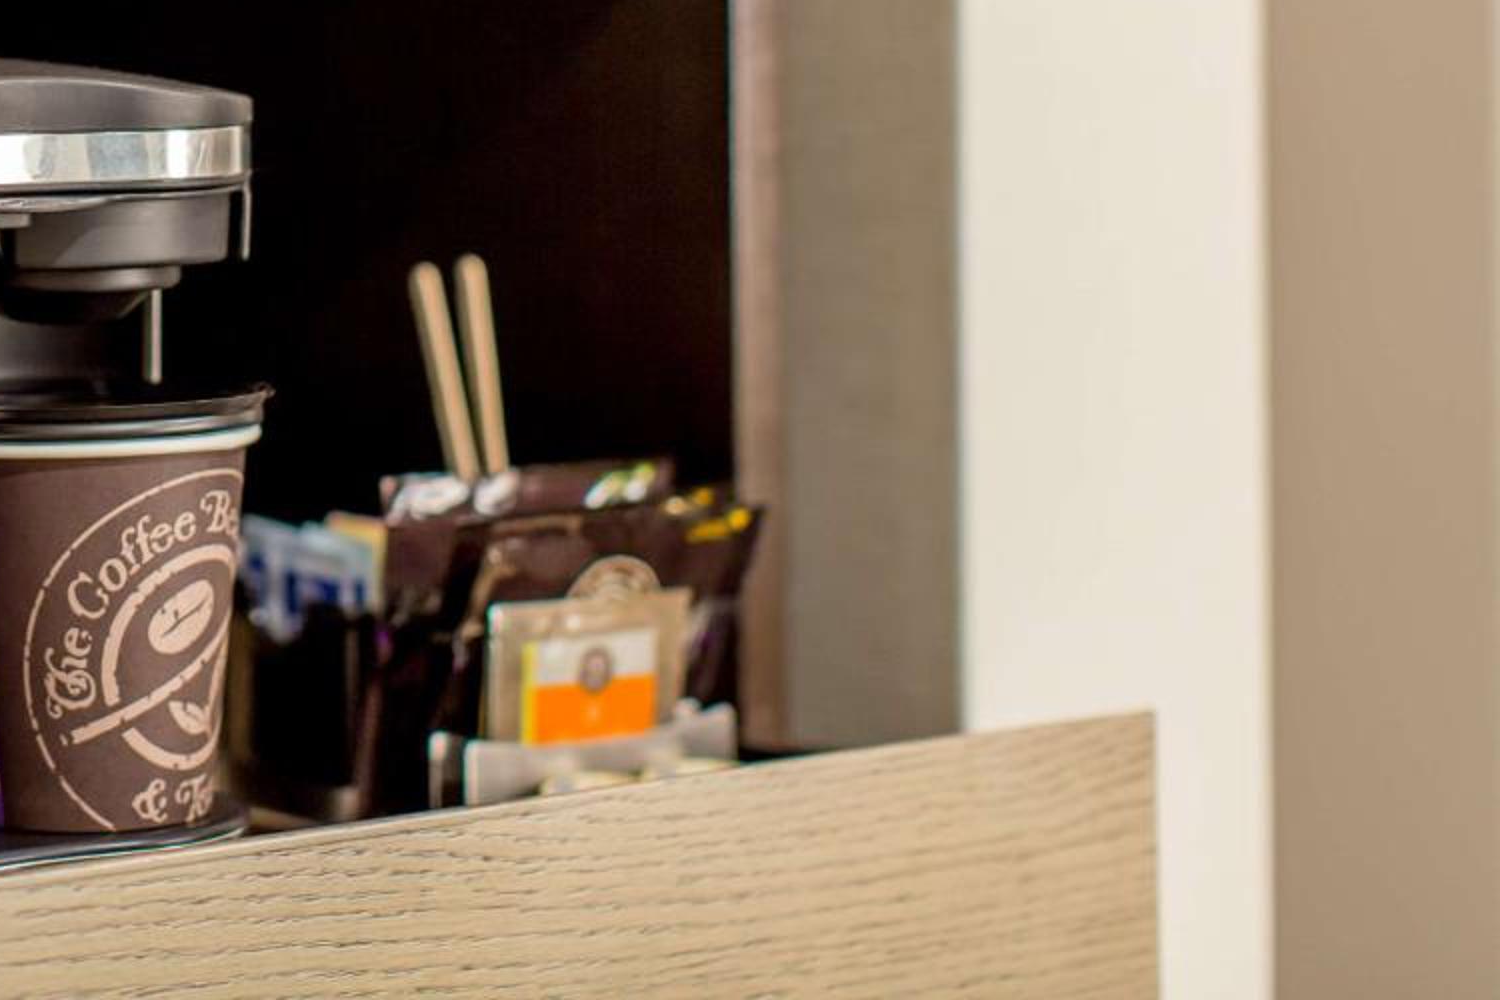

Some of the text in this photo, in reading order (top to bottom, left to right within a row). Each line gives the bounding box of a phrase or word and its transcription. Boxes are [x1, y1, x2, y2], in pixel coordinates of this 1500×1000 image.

[44, 489, 239, 719] The Coffee Be
[132, 778, 168, 823] &
